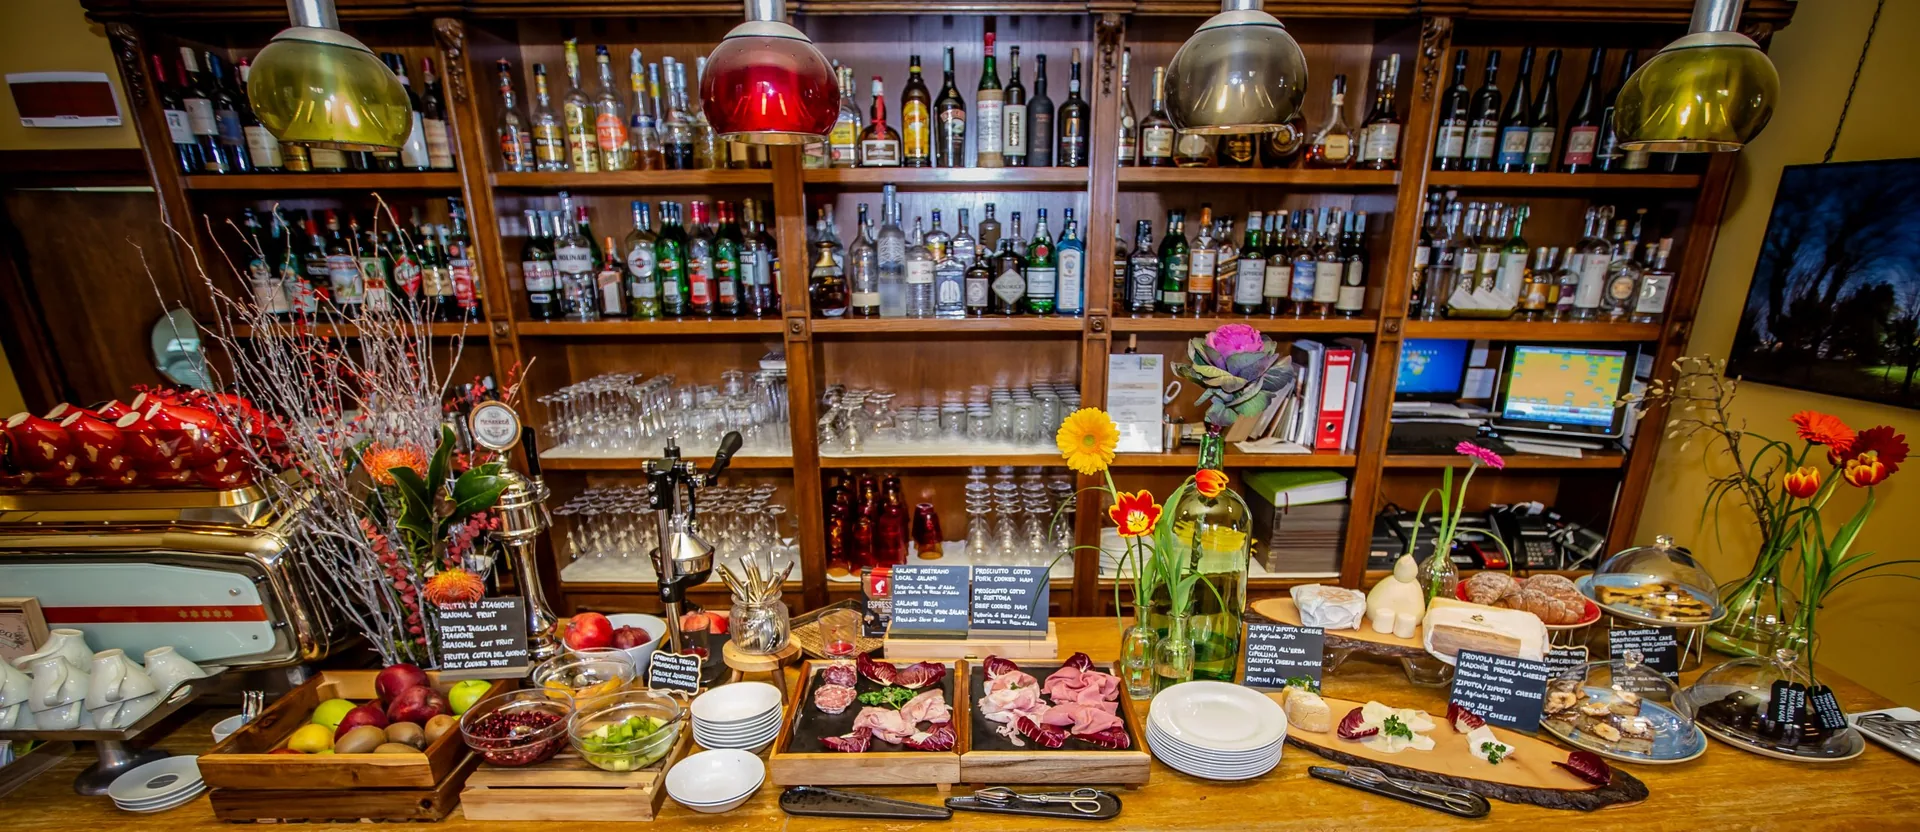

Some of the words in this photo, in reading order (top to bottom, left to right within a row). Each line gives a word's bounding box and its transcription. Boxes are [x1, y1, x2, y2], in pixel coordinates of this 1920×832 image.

[440, 602, 467, 610] FRUTTA
[1461, 652, 1493, 664] PROVOLA
[1494, 658, 1516, 667] DELLE
[1493, 666, 1521, 676] PROVOLA
[1477, 702, 1493, 712] SALE
[1489, 712, 1516, 722] CHEESE
